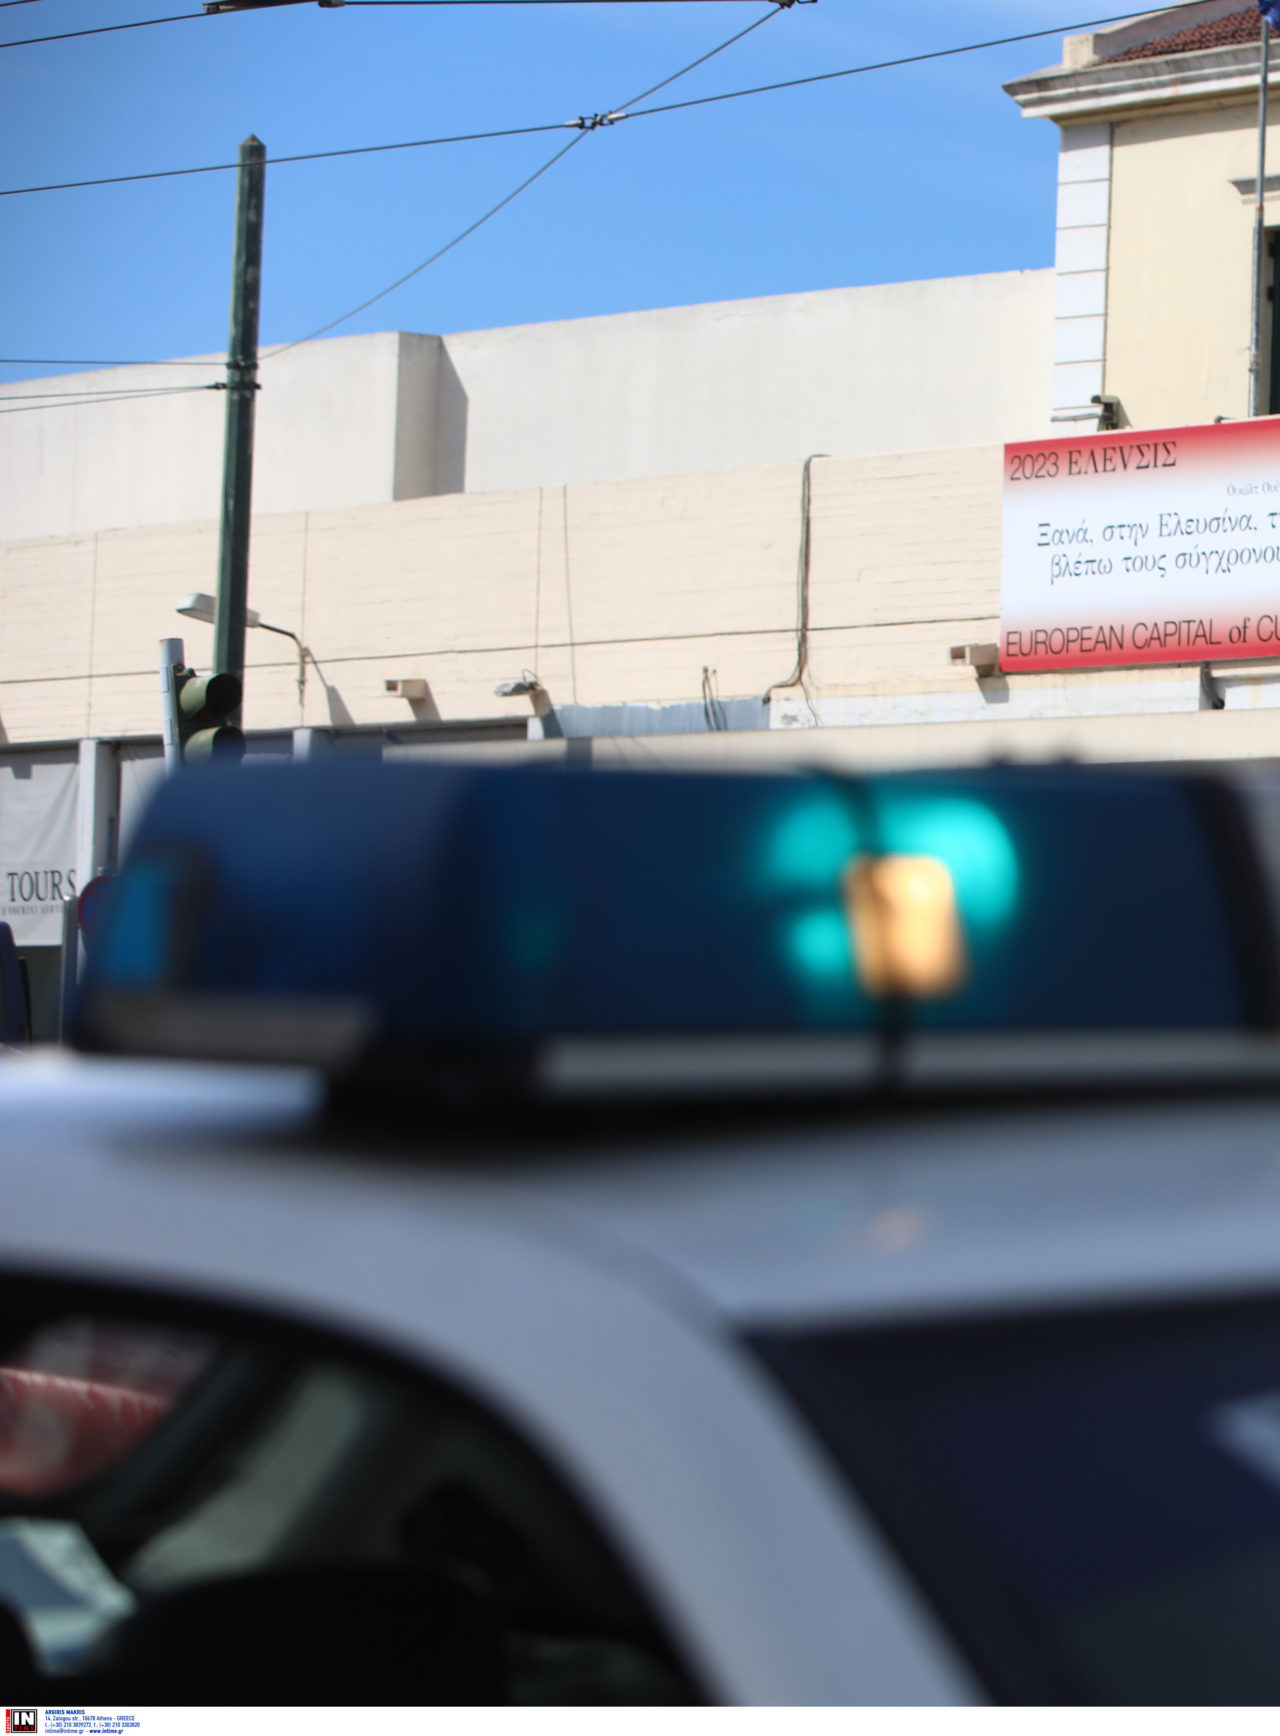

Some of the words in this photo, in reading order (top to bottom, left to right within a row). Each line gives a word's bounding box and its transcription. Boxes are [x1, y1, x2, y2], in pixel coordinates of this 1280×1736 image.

[1009, 451, 1060, 481] 2023
[1102, 521, 1150, 547] στην
[1050, 551, 1113, 586] βλέπω
[1122, 552, 1168, 578] τους
[1005, 624, 1125, 658] EUROPEAN
[1132, 618, 1222, 650] CAPITAL
[1228, 617, 1251, 645] of
[7, 869, 77, 903] TOURS
